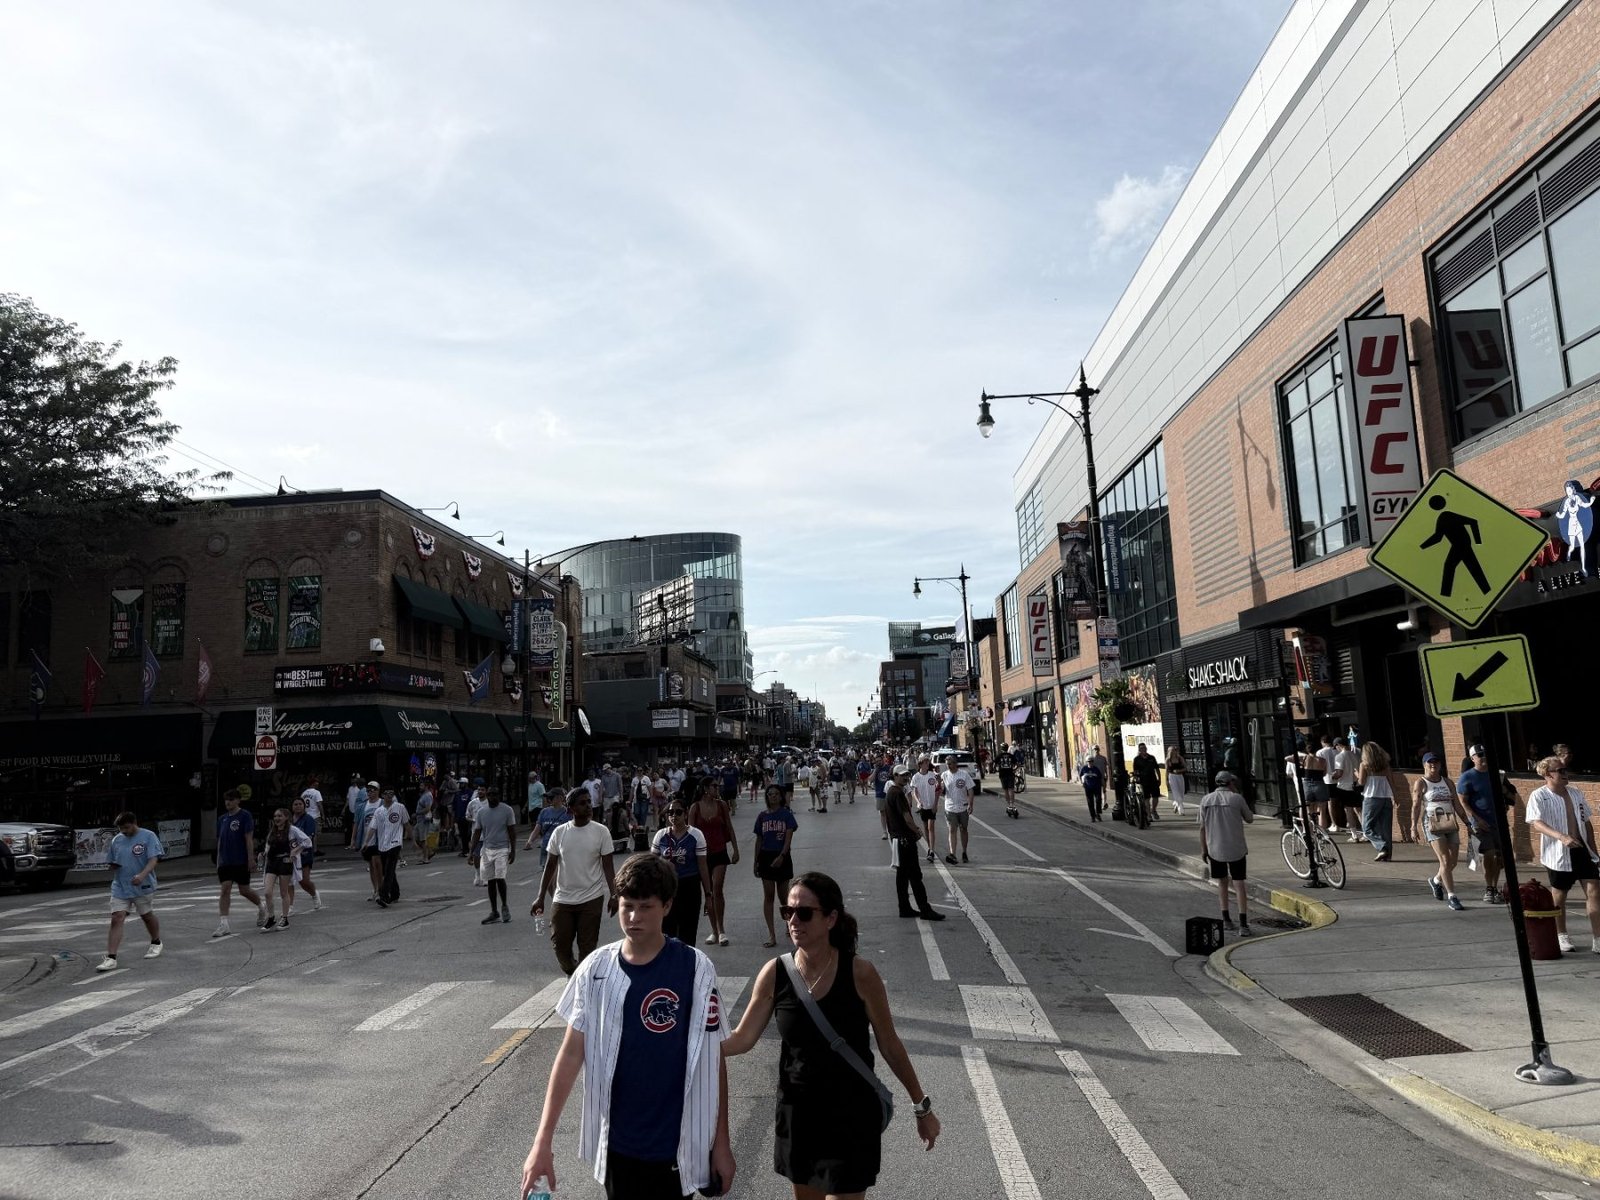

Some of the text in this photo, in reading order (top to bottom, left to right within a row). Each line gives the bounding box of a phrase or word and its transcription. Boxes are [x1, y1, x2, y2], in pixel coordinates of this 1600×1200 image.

[1357, 335, 1409, 474] UFC
[1551, 571, 1581, 590] LIVE
[1030, 602, 1048, 652] UFC
[933, 632, 956, 641] Gallag
[1034, 659, 1051, 667] GYM
[292, 669, 310, 680] BEST
[1188, 656, 1249, 689] SHAKE SHACK
[275, 680, 282, 688] IN
[274, 712, 326, 738] luggers
[282, 744, 309, 754] SPORTS
[310, 743, 325, 752] BAR
[325, 743, 342, 751] AND
[342, 741, 366, 750] GRILL
[13, 757, 39, 767] FOOD
[40, 756, 51, 765] IN
[52, 753, 121, 764] WRIGLEYVILLE
